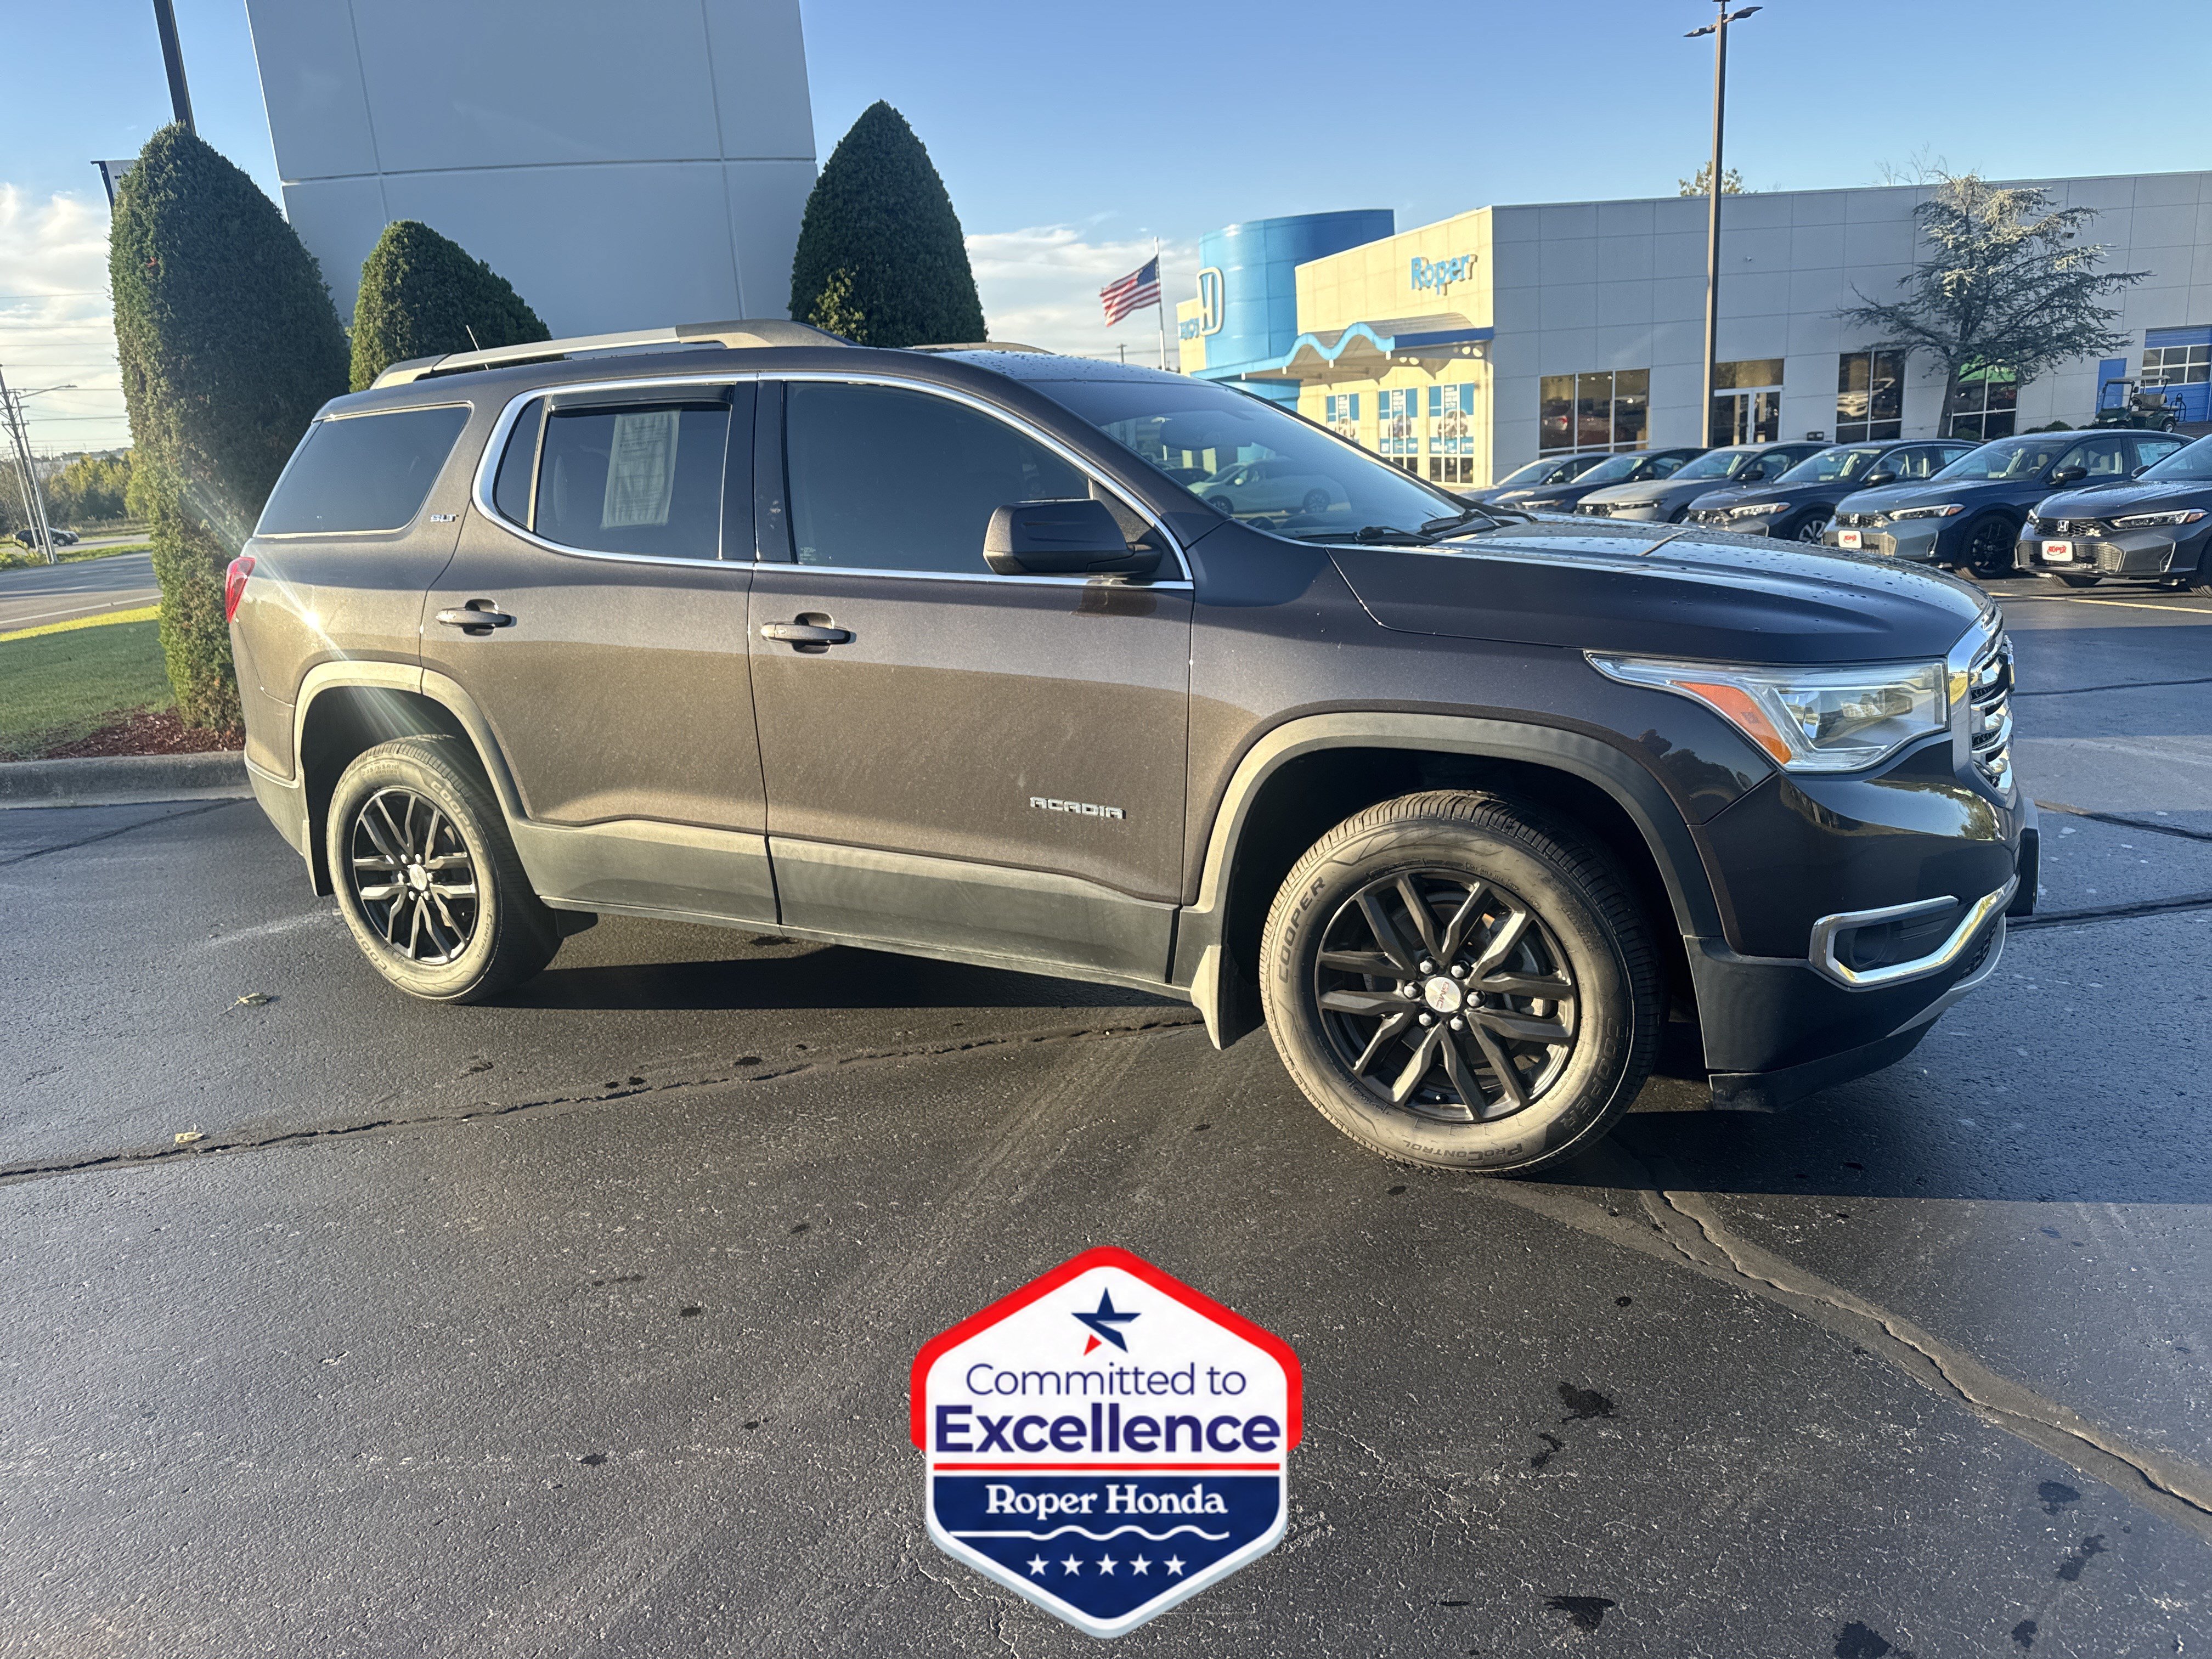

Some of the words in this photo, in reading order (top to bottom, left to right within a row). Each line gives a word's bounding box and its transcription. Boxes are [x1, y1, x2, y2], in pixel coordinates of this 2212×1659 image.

[1411, 254, 1471, 296] Roper
[430, 514, 457, 523] SLT
[431, 780, 483, 854] COOPER
[1030, 797, 1124, 820] ACADIA
[1278, 876, 1325, 984] COOPER
[1436, 981, 1450, 1009] GMC
[1560, 1017, 1620, 1132] COOPER
